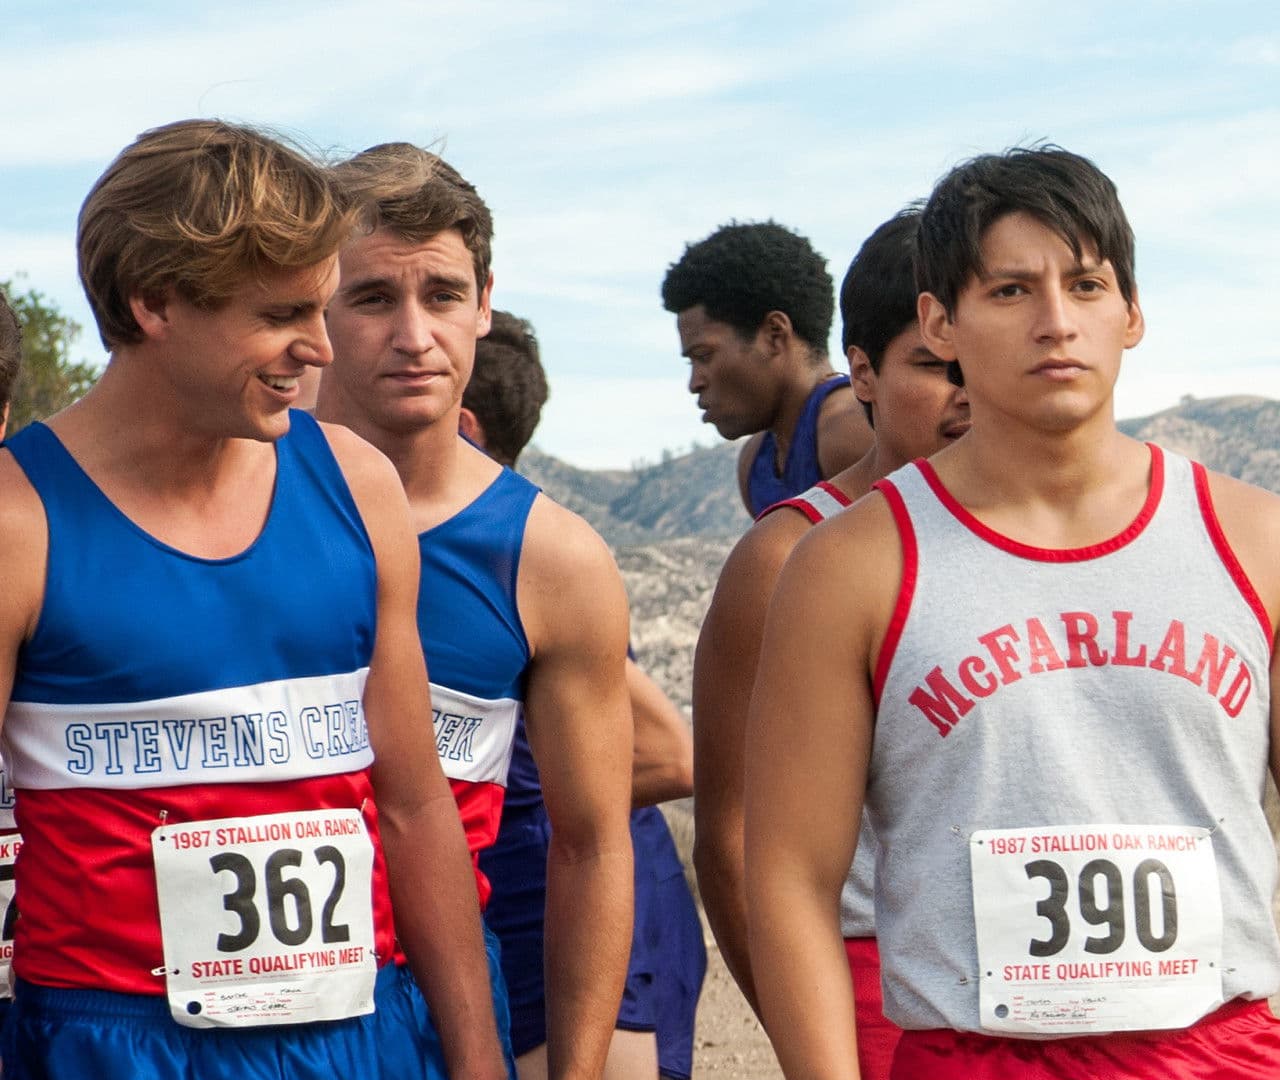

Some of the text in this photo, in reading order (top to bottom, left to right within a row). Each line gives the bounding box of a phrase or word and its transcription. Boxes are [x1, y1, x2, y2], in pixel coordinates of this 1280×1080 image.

[907, 611, 1252, 738] McFARLAND
[66, 711, 290, 775] STEVENS
[171, 819, 360, 849] 1987 STALLION OAK RANCH
[990, 831, 1198, 855] 1987 STALLION OAK RANCH
[209, 845, 351, 953] 362
[1024, 859, 1178, 958] 390
[192, 946, 364, 979] STATE QUALIFYING MEET
[1004, 959, 1198, 980] STATE QUALIFYING MEET
